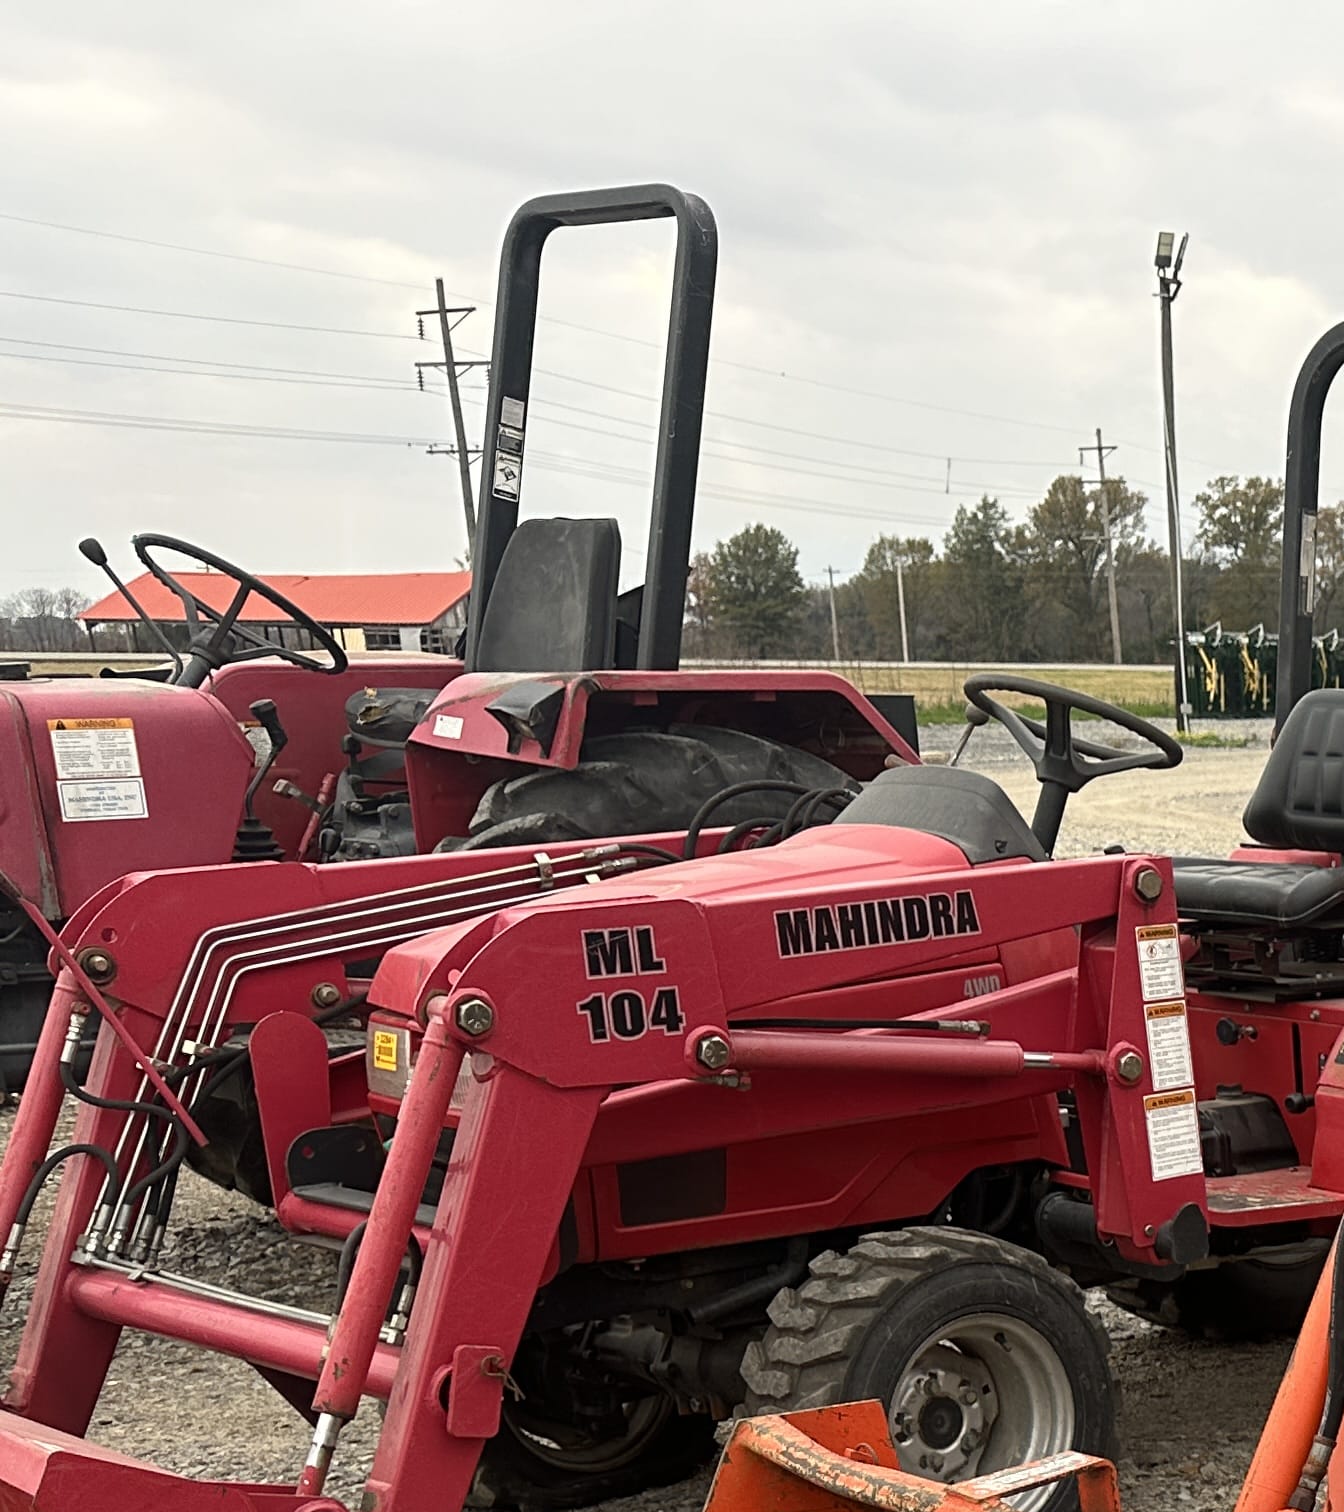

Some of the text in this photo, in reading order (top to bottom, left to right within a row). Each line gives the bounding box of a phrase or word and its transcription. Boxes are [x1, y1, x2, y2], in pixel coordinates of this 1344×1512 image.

[773, 889, 981, 958] MAHINDRA
[581, 925, 667, 980] ML
[964, 975, 1000, 997] 4WD
[577, 986, 686, 1044] 104
